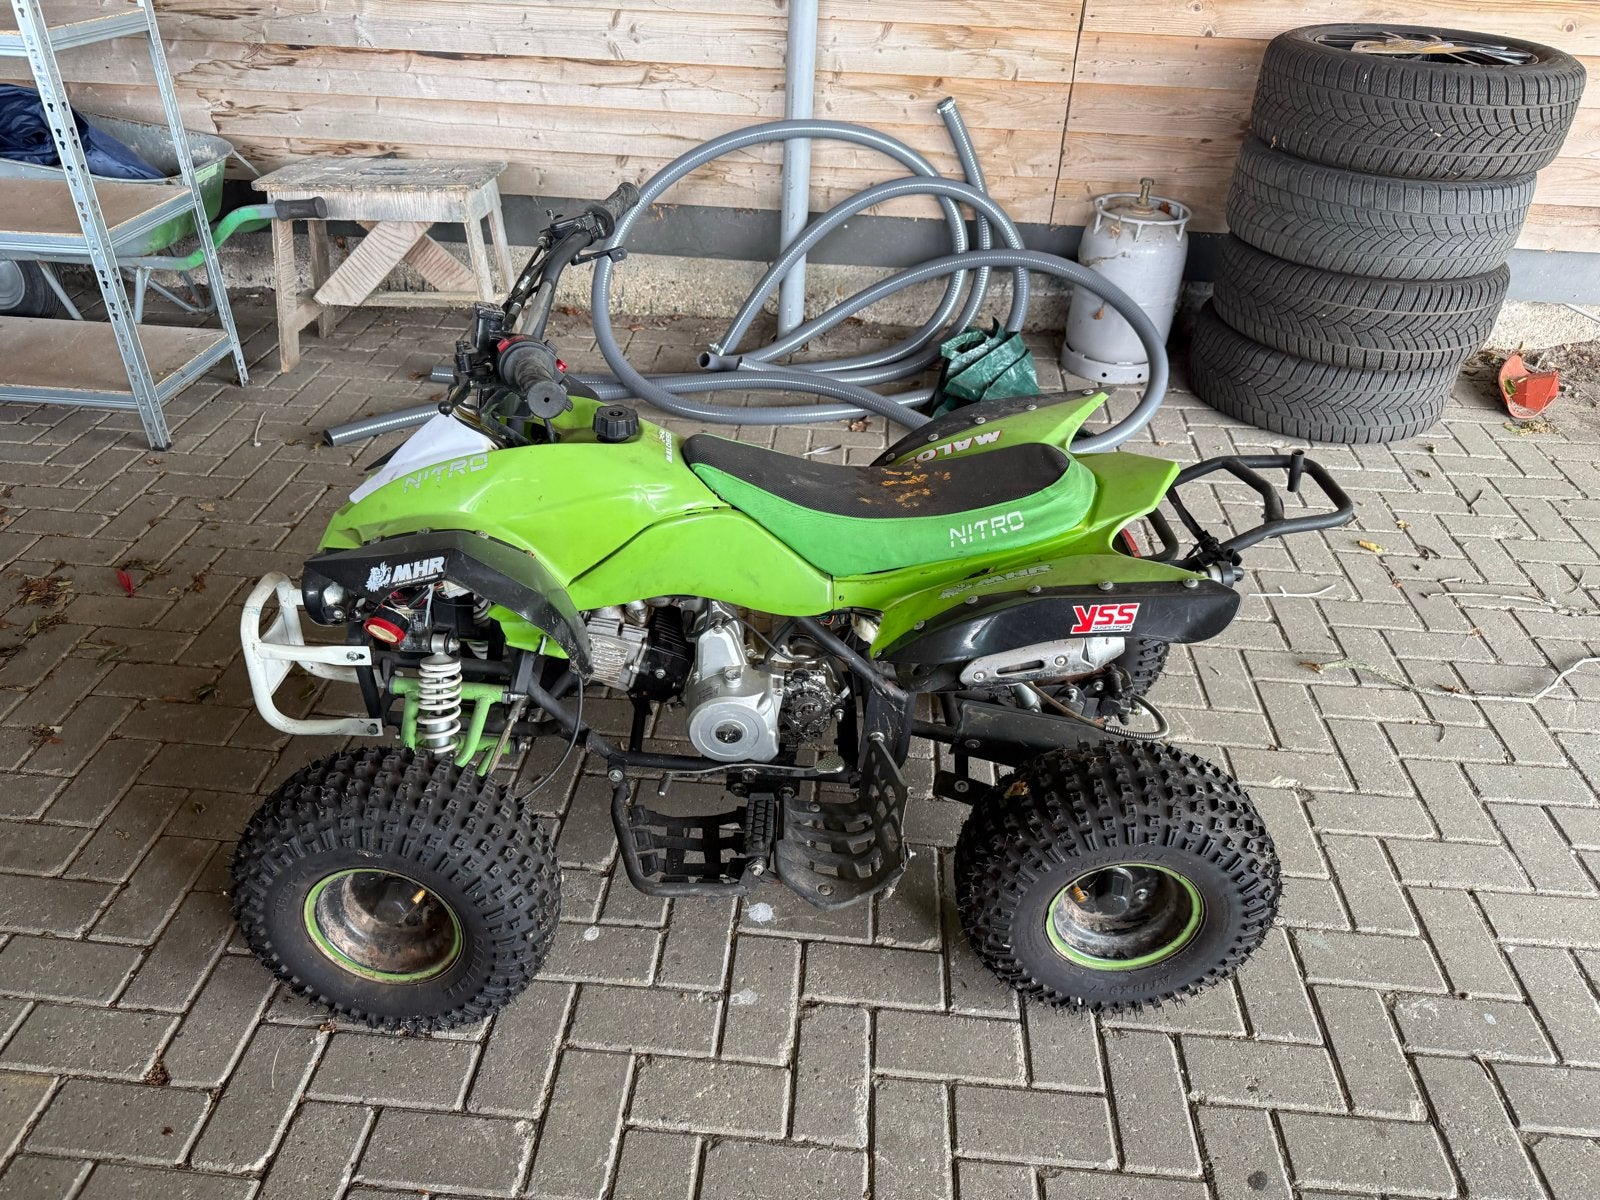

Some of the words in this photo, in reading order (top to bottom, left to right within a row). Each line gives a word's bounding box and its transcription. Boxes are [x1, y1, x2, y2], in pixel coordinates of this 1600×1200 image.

[905, 430, 1001, 463] MALO
[403, 453, 489, 494] NITRO
[949, 510, 1025, 548] NITRO
[391, 556, 445, 583] MHR
[1072, 605, 1139, 633] YSS
